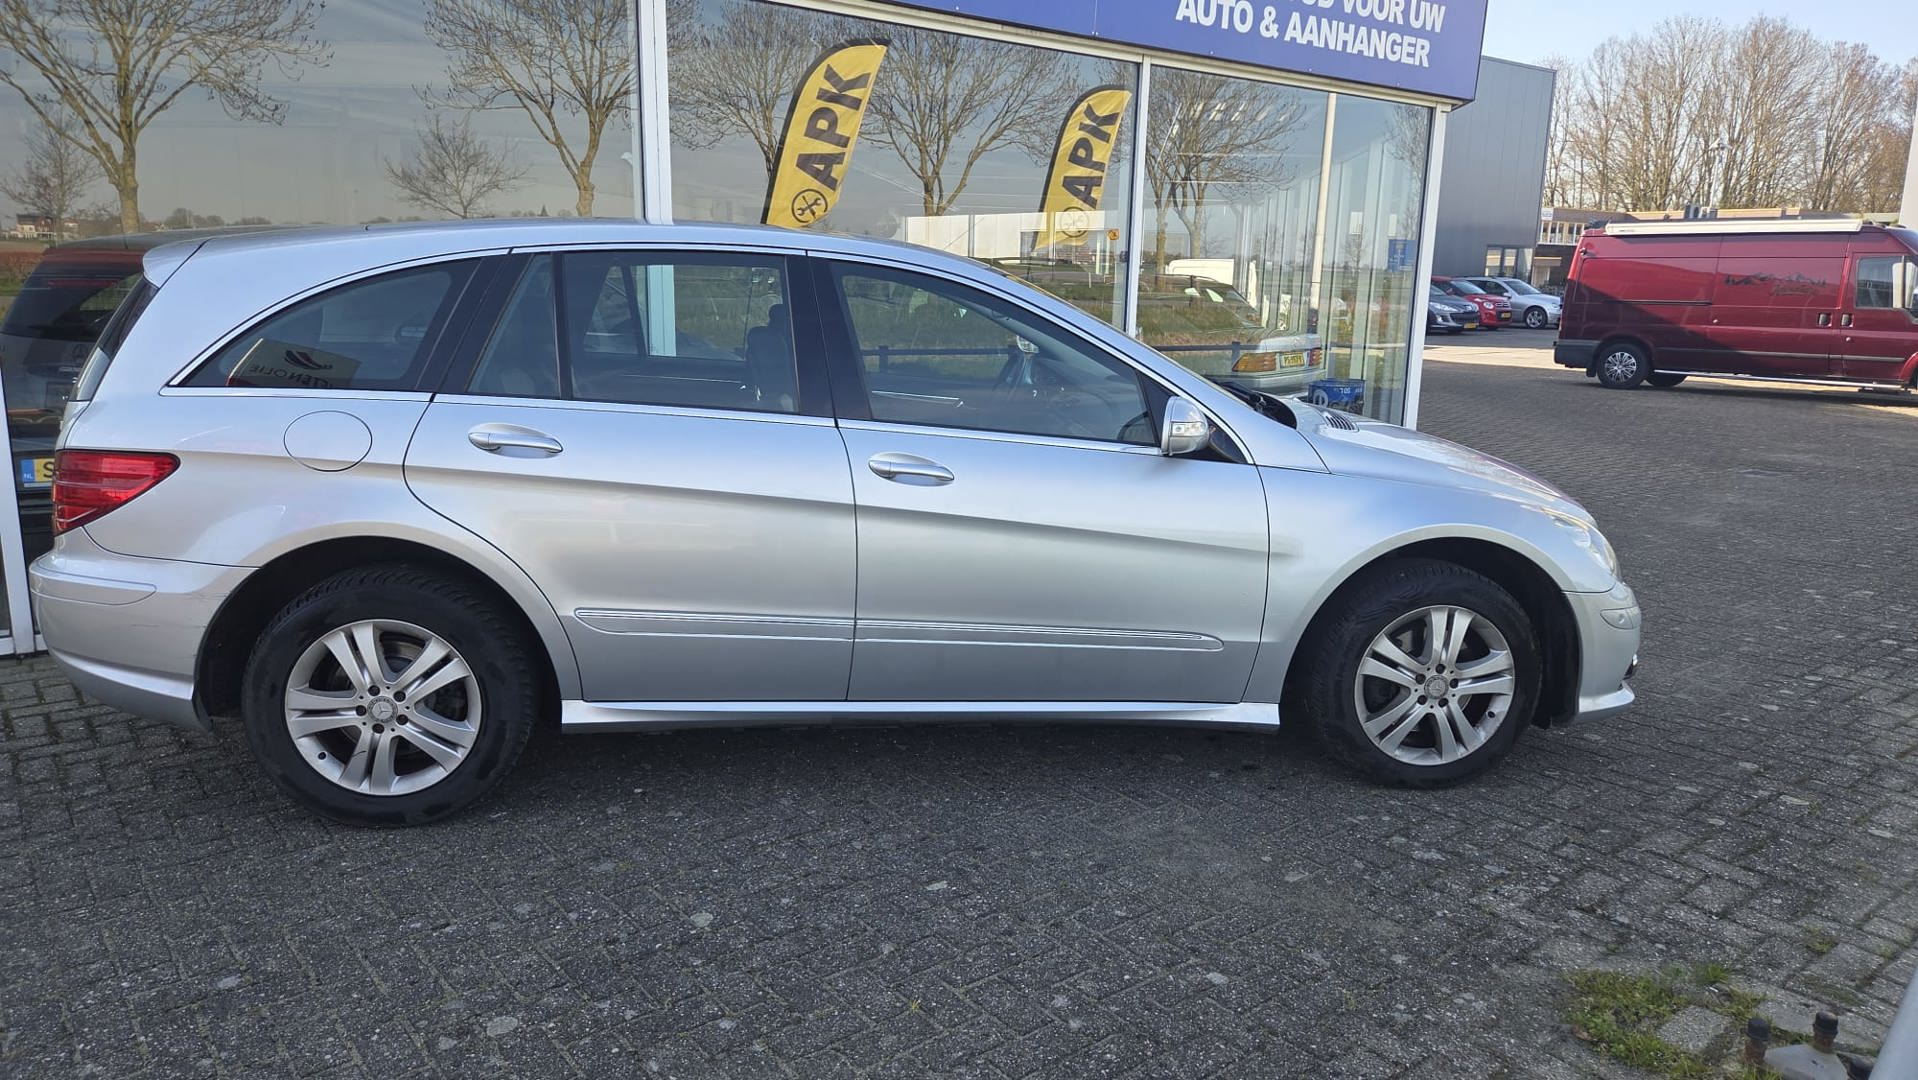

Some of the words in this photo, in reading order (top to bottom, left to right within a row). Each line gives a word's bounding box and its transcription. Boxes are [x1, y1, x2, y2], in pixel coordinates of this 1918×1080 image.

[1175, 0, 1254, 33] AUTO
[1259, 5, 1279, 40] &
[1284, 12, 1431, 68] AANHANGER
[1410, 0, 1447, 33] UW
[795, 63, 871, 192] APK
[1061, 102, 1119, 210] APK
